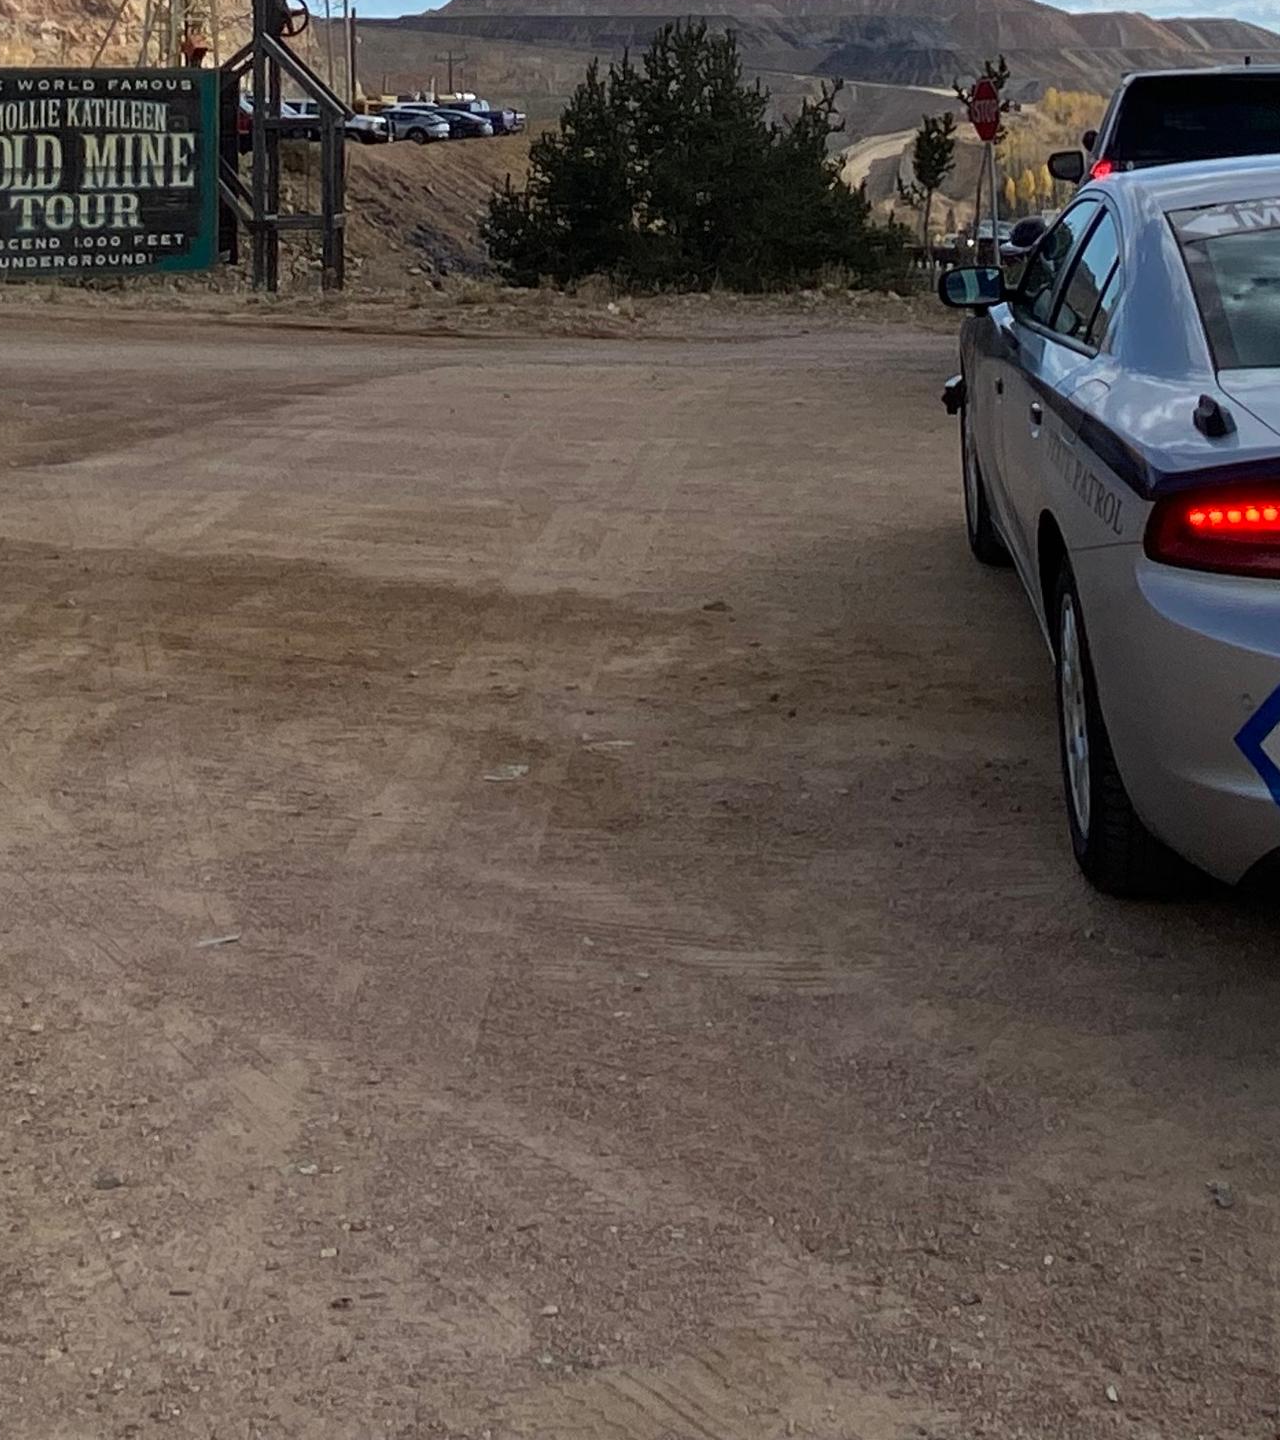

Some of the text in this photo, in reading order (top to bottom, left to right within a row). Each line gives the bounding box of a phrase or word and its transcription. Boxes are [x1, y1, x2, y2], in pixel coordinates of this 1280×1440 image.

[18, 79, 95, 91] WORLD
[108, 79, 193, 91] FAMOUS
[67, 97, 169, 132] KATHLEEN
[970, 100, 998, 123] STOP
[81, 133, 195, 188] MINE
[10, 194, 144, 231] TOUR
[134, 234, 185, 246] FEET
[1072, 459, 1124, 535] PATROL
